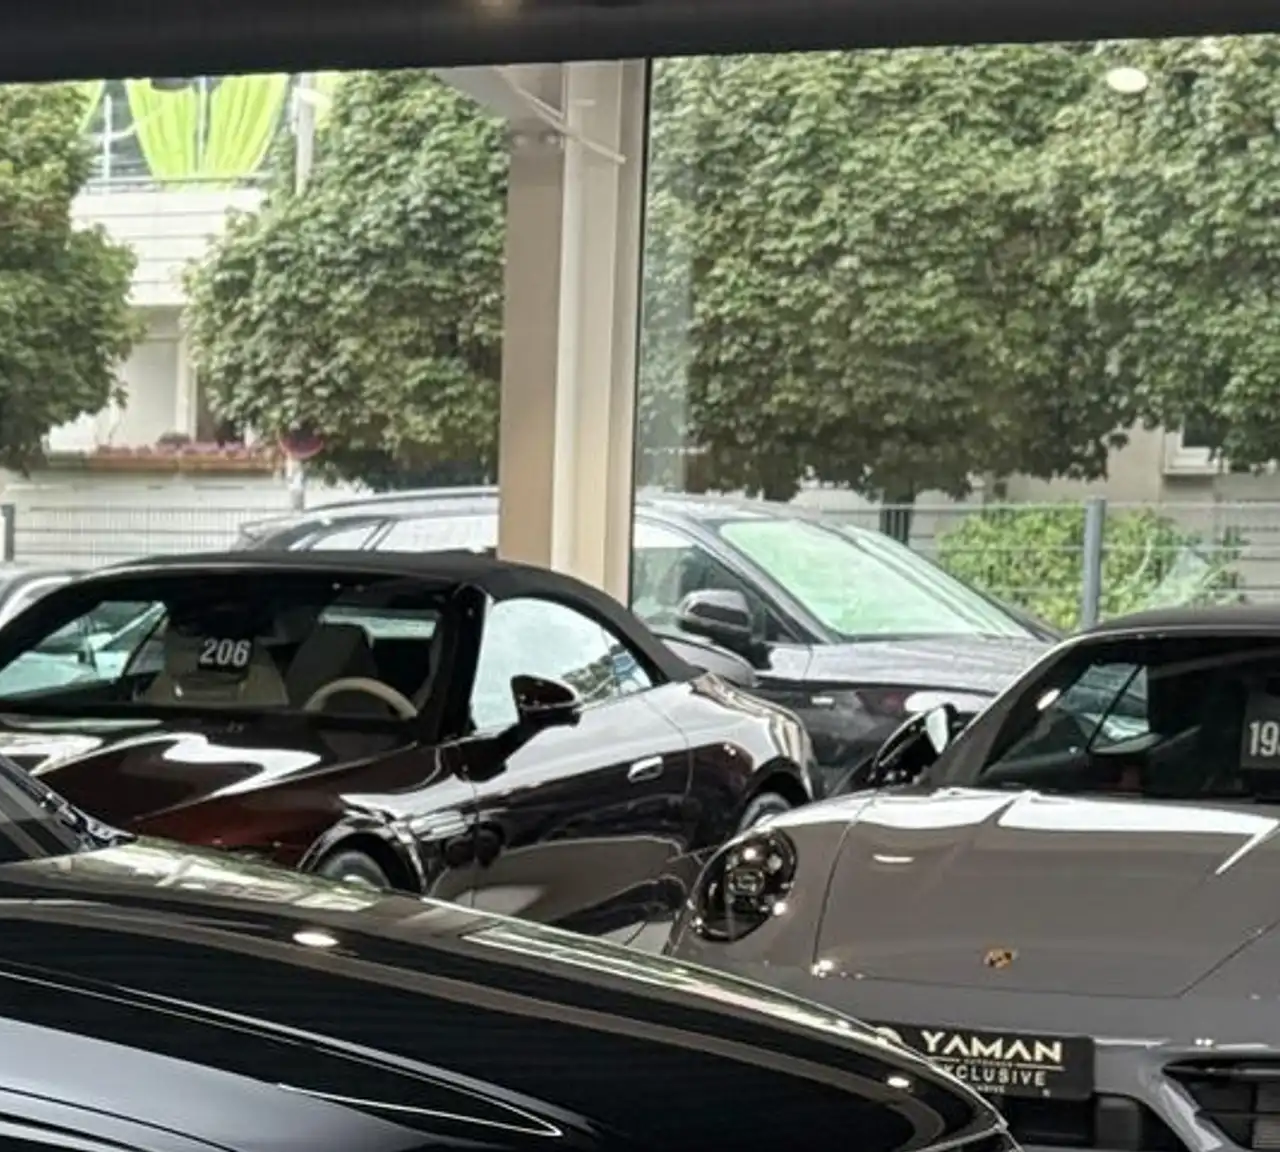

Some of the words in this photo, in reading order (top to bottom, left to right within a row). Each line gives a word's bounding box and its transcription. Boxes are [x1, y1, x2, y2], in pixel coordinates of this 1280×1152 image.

[199, 637, 252, 668] 206
[1248, 720, 1280, 757] 19
[920, 1030, 1063, 1063] YAMAN
[943, 1064, 1047, 1087] XCLUSIVE
